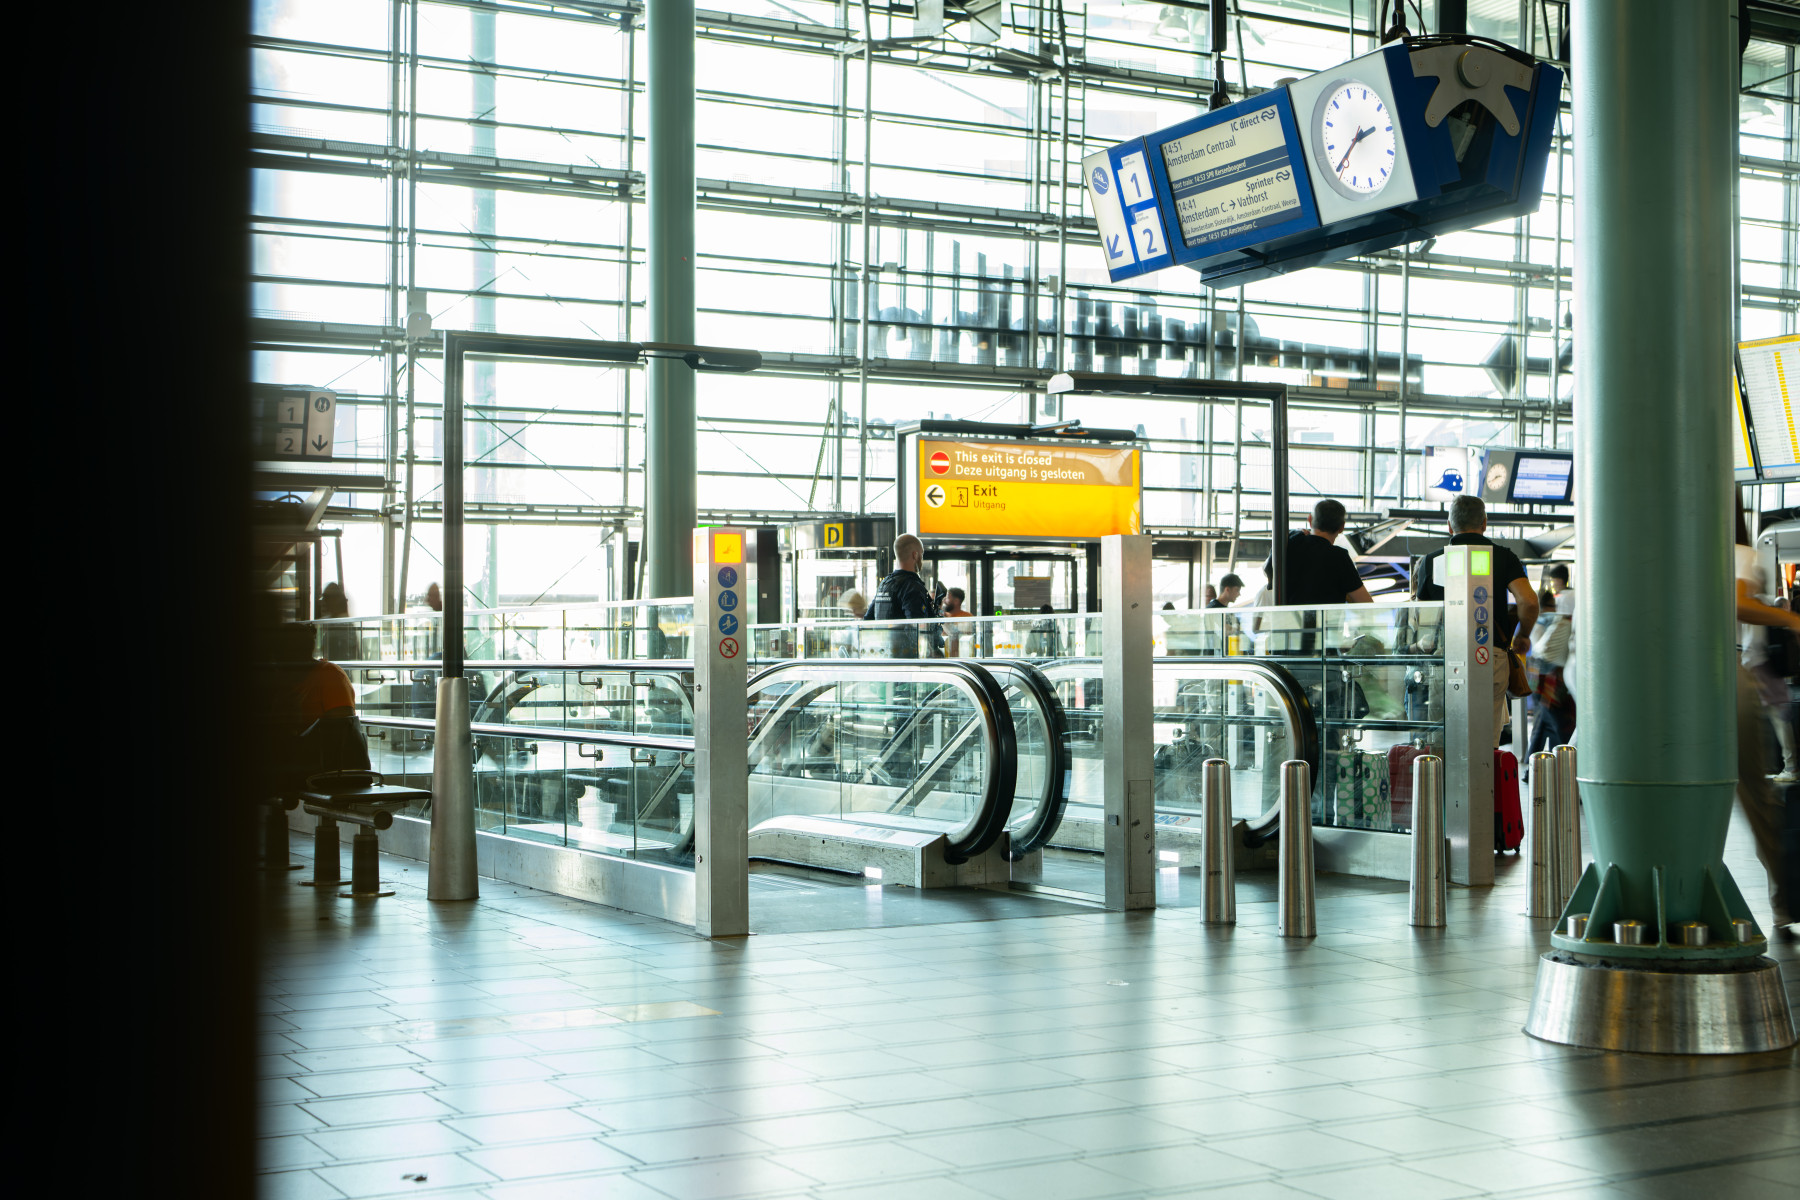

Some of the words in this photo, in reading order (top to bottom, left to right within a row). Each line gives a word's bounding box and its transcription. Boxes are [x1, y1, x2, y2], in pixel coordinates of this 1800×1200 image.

[1230, 121, 1239, 132] IC
[1239, 115, 1260, 130] direct
[1164, 141, 1182, 156] 14:51
[1167, 148, 1206, 168] Amsterdam
[1206, 135, 1236, 155] Centraal
[1130, 172, 1142, 198] 1
[1194, 173, 1206, 184] 14:53
[1206, 171, 1214, 180] SPR
[1245, 176, 1274, 193] Sprinter
[1178, 198, 1197, 213] 14:41
[1181, 206, 1220, 225] Amsterdam
[1220, 201, 1229, 212] C.
[1237, 190, 1269, 208] Vathorst
[1190, 221, 1215, 234] Amsterdam
[1236, 209, 1262, 221] Amsterdam
[1281, 198, 1297, 209] Weesp
[1143, 228, 1158, 255] 2
[1187, 237, 1197, 247] Next
[1208, 232, 1220, 241] 14:51
[1228, 224, 1253, 237] Amsterdam
[287, 407, 294, 421] 1
[283, 438, 294, 452] 2
[955, 450, 978, 463] This
[981, 452, 1003, 464] exit
[1006, 452, 1015, 464] is
[1017, 452, 1052, 466] closed
[955, 465, 983, 476] Deze
[985, 466, 1027, 480] uitgang
[1030, 467, 1038, 478] is
[1041, 467, 1085, 481] gesloten
[973, 484, 998, 497] Exit
[973, 499, 1006, 511] Uitgang
[828, 527, 840, 545] D
